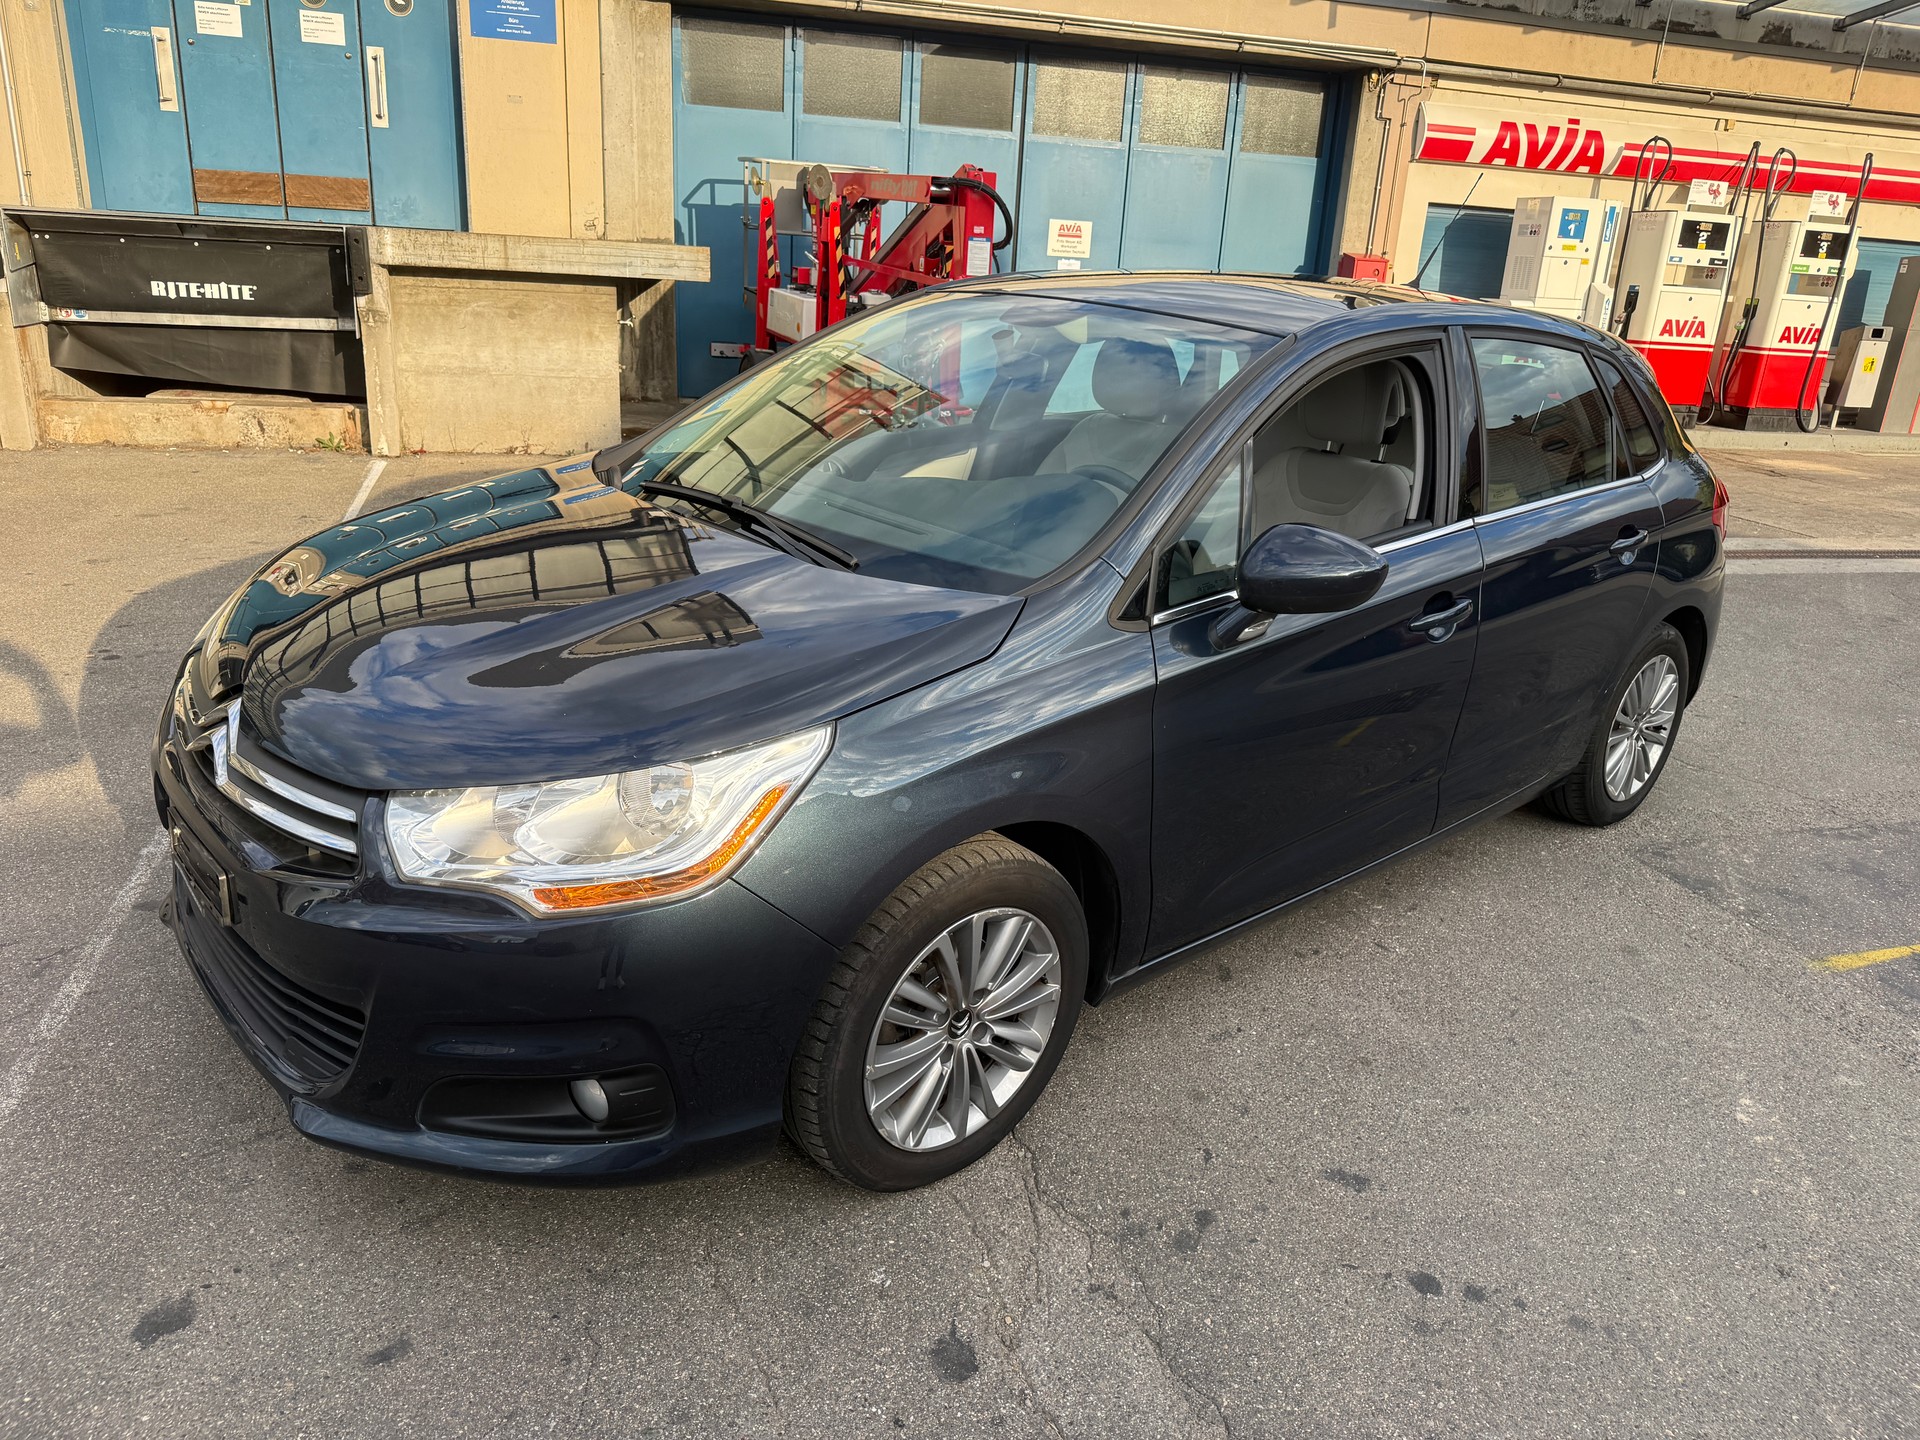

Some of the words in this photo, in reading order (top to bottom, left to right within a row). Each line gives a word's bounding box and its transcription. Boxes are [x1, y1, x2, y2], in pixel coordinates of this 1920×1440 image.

[1479, 117, 1605, 174] AVIA
[1058, 222, 1082, 233] AVIA
[1567, 222, 1577, 237] 1
[1698, 231, 1708, 243] 2
[1819, 241, 1828, 253] 3
[1658, 315, 1706, 339] AVIA
